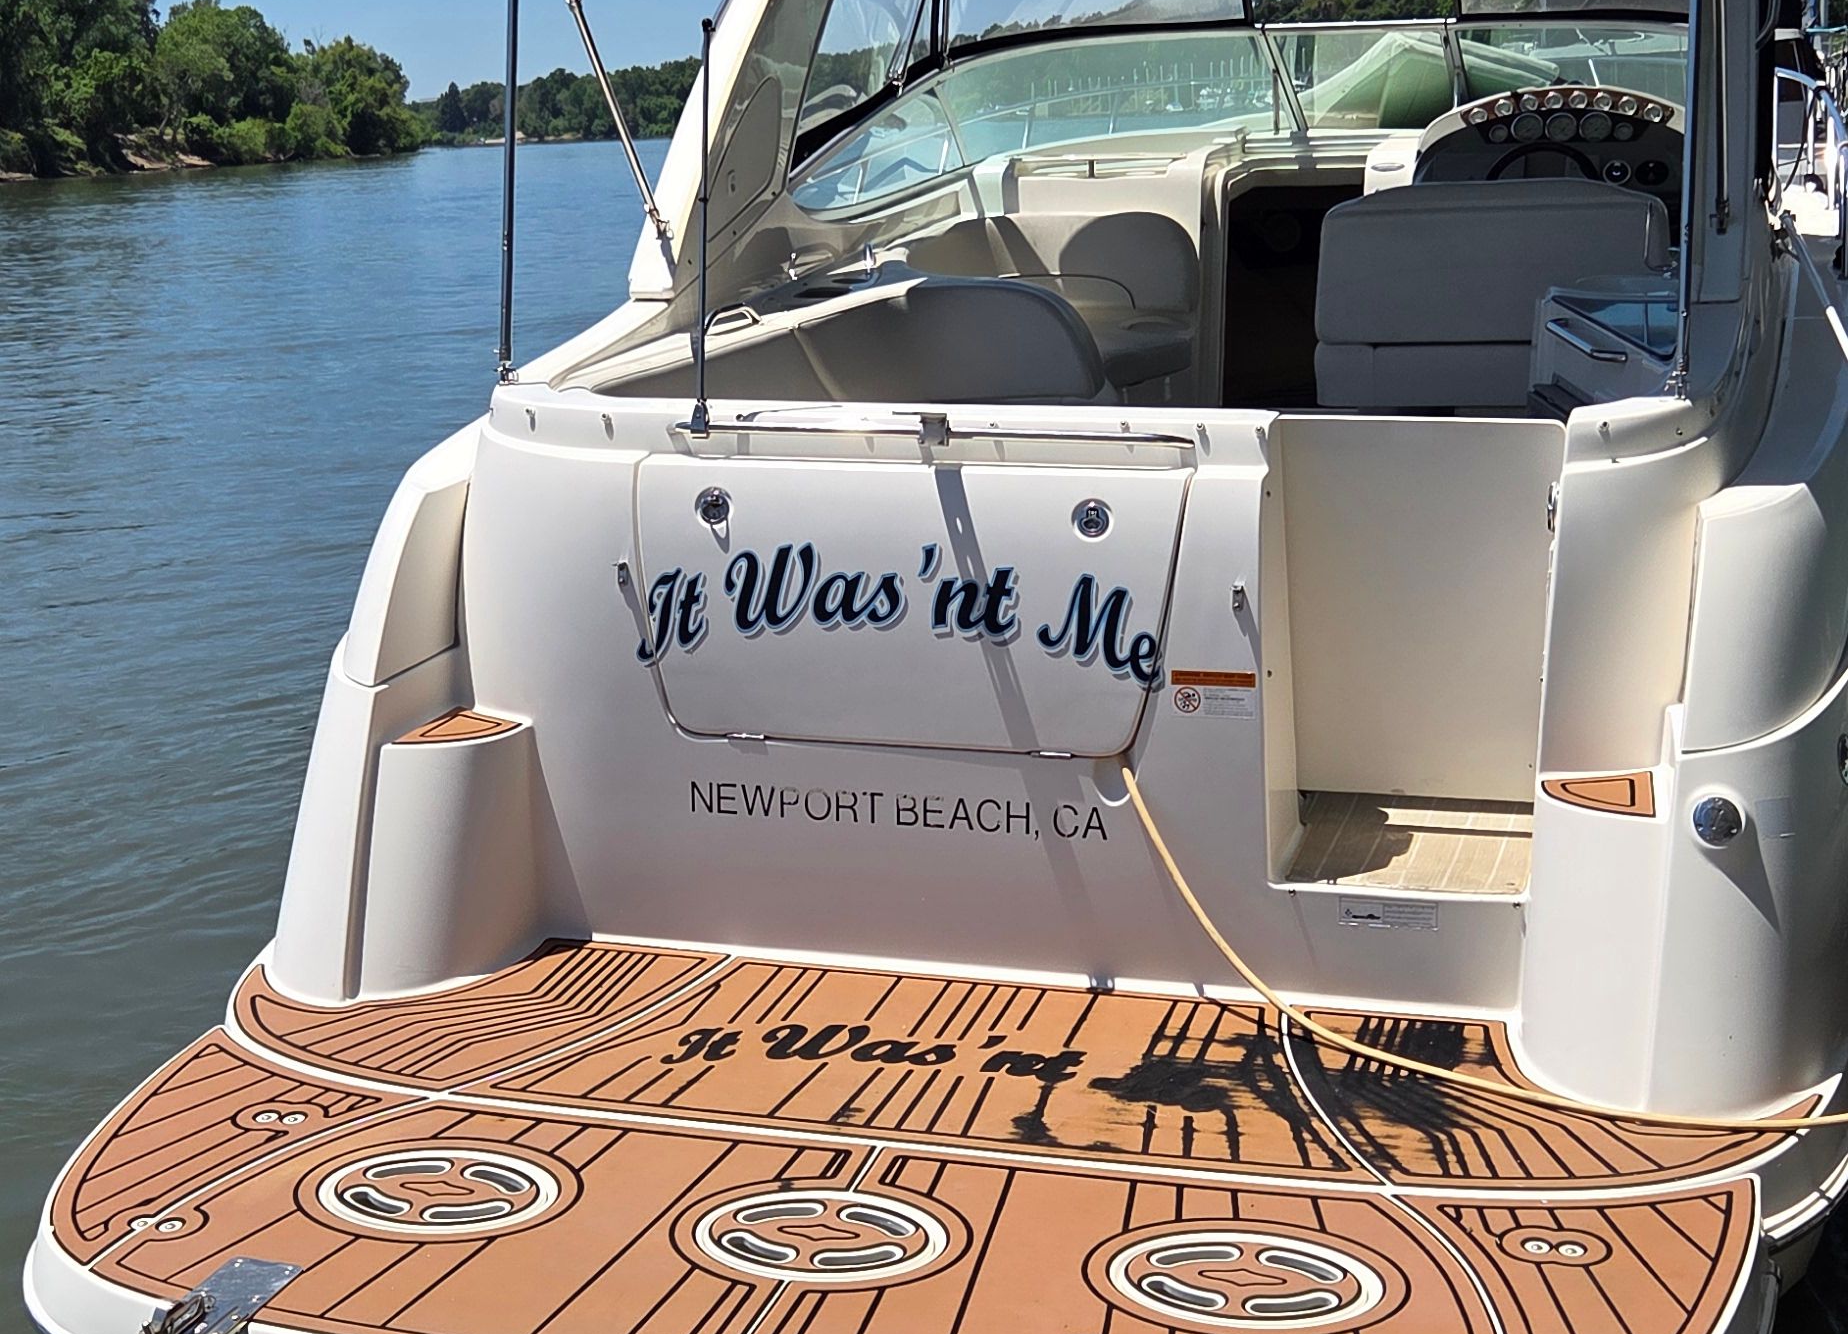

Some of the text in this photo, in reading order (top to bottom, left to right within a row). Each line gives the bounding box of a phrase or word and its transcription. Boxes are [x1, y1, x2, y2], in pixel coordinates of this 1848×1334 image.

[636, 541, 1163, 687] It Was'nt Me
[690, 781, 1108, 840] NEWPORT BEACH, CA
